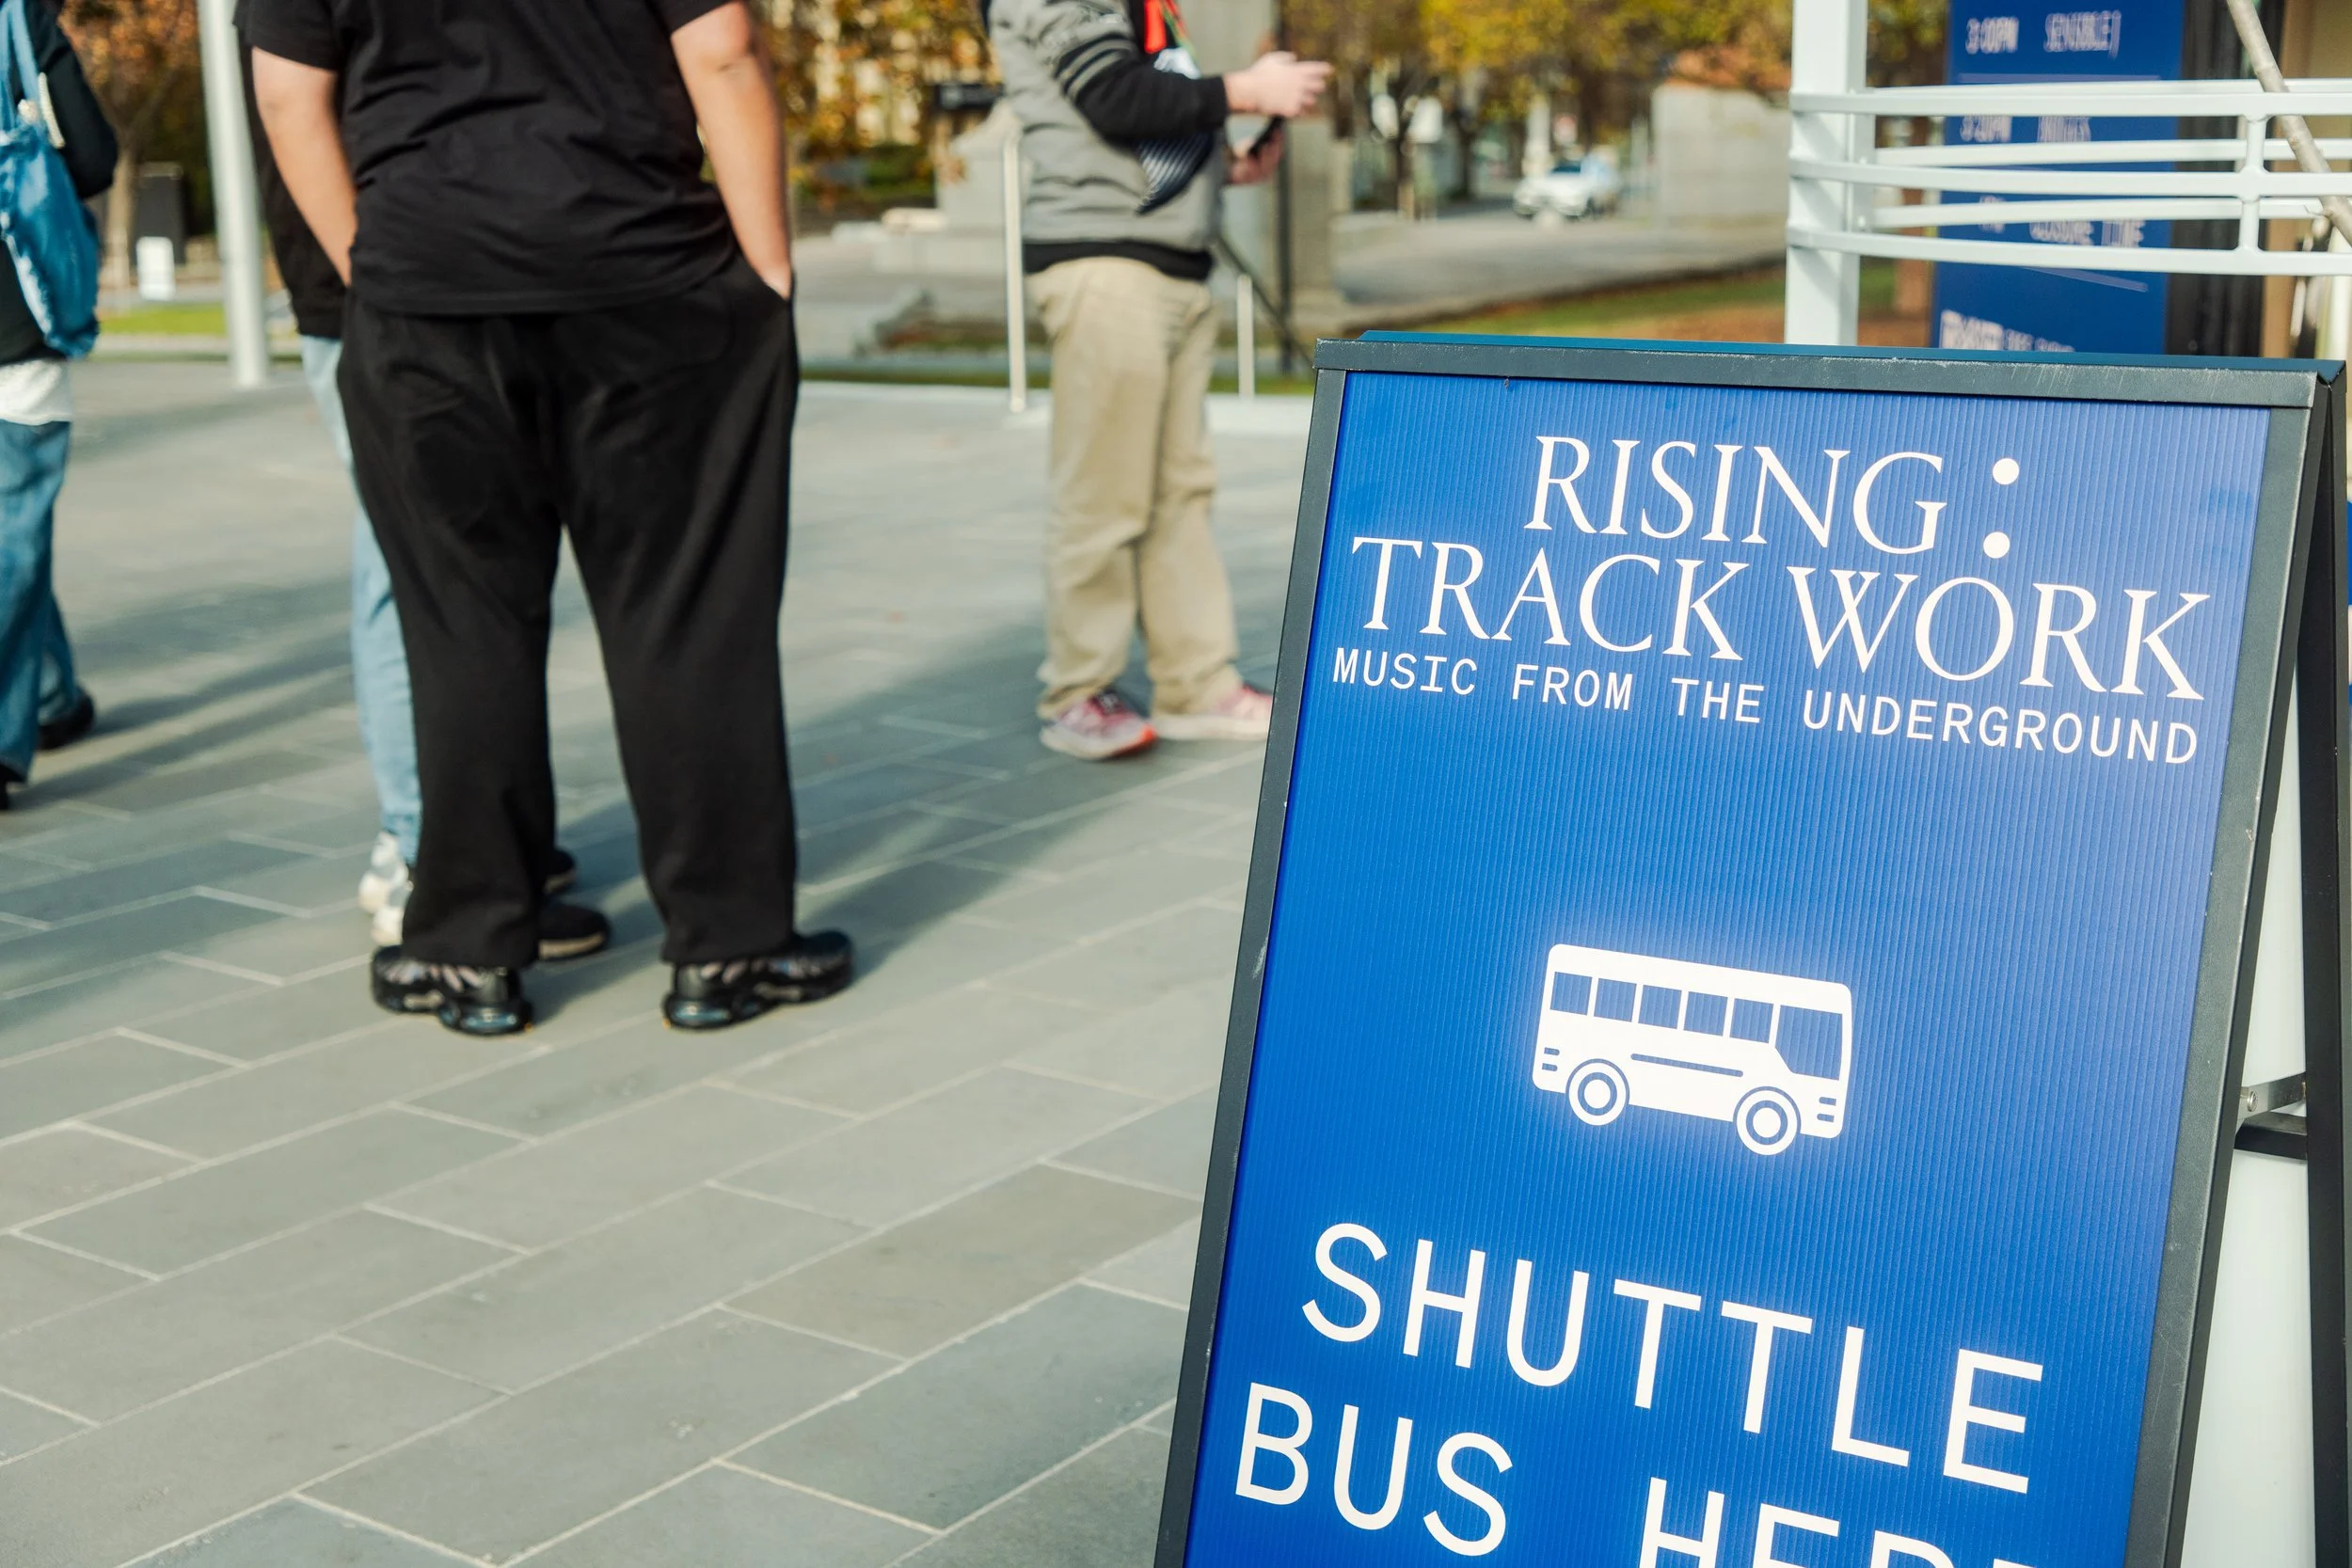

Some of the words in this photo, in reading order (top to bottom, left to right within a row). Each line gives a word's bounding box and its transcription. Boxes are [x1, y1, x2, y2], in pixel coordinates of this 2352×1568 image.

[1352, 536, 1750, 661] TRACK
[1786, 565, 2211, 703] WORK
[1332, 647, 1478, 695] MUSIC
[1512, 663, 1633, 711] FROM
[1671, 677, 1765, 723] THE
[1803, 689, 2198, 765] UNDERGROUND
[1302, 1223, 2043, 1494] SHUTTLE
[1235, 1382, 1513, 1557] BUS
